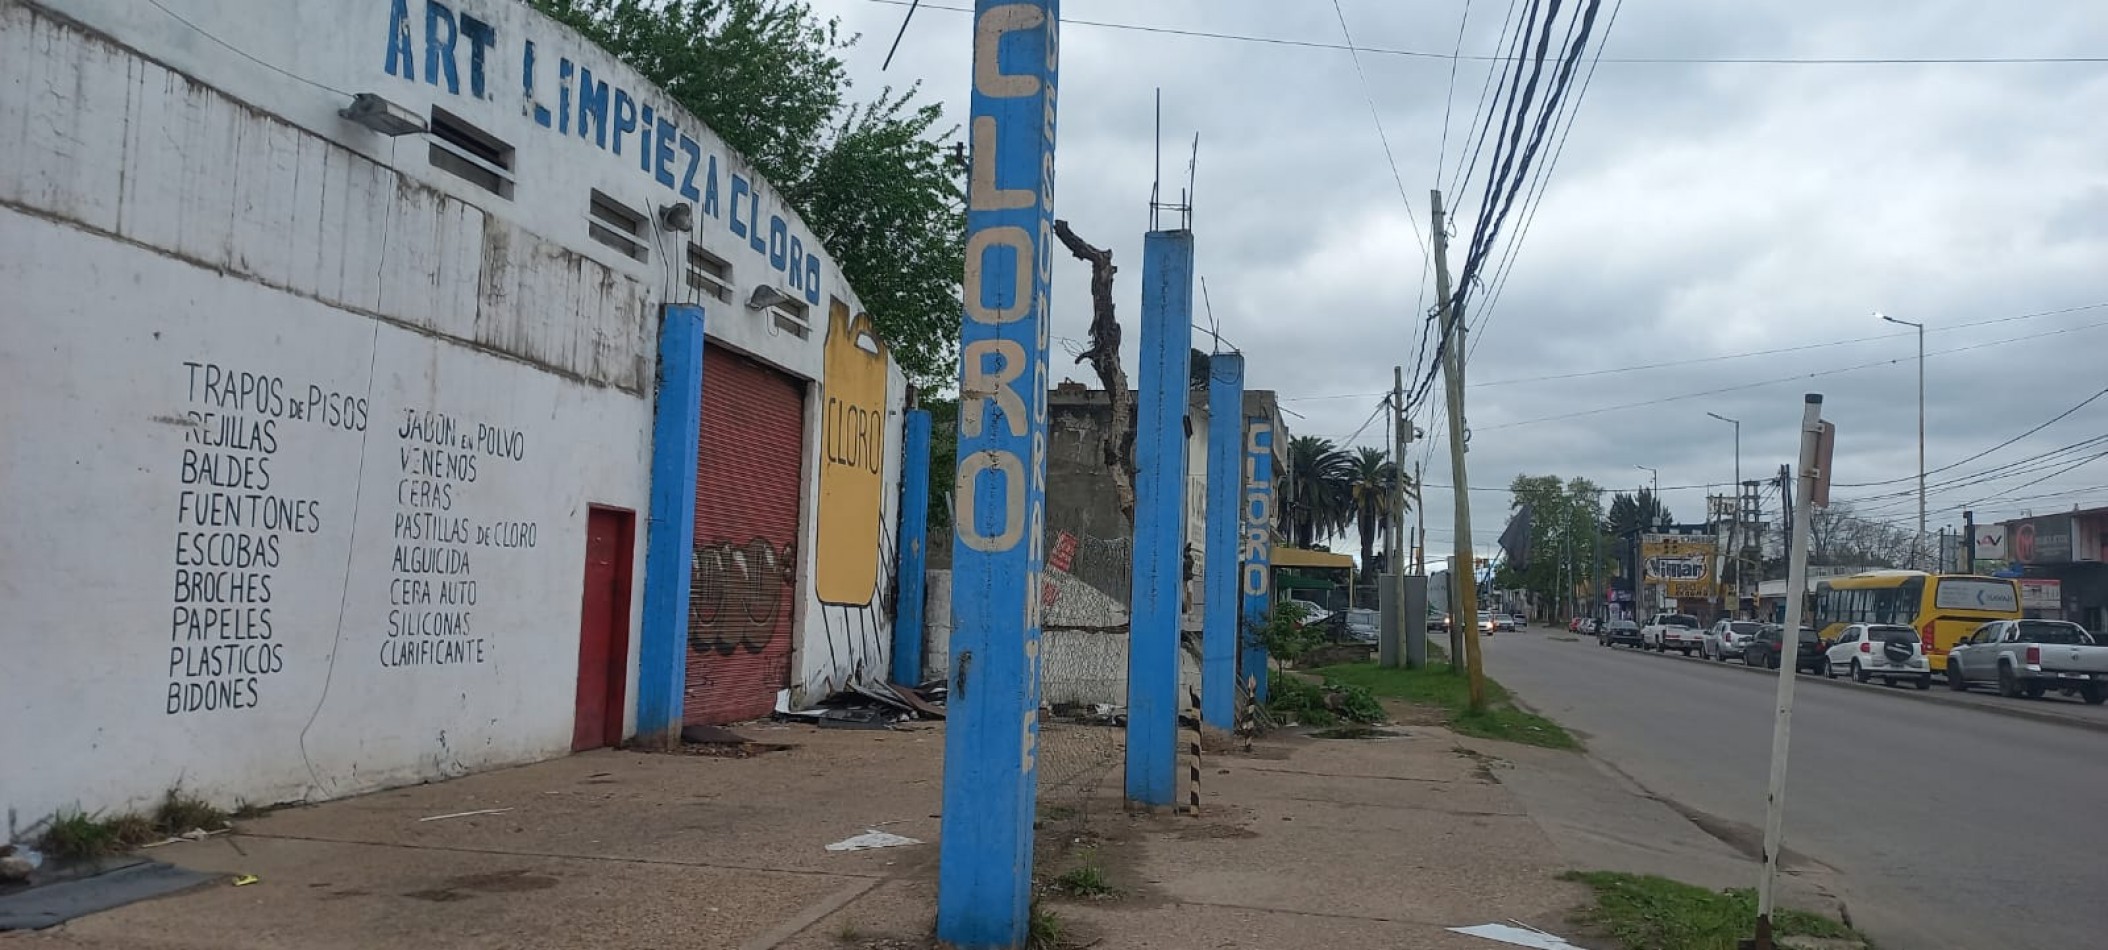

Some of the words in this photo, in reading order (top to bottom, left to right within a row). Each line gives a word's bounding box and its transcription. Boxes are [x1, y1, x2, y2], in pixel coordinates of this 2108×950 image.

[729, 173, 821, 306] CLORO
[956, 3, 1044, 552] CLORO
[183, 361, 283, 417] TRAPOS
[290, 398, 304, 420] DE
[307, 384, 367, 431] PISOS
[1022, 8, 1057, 773] DESODORANTE
[185, 410, 278, 454] REJILLAS
[461, 434, 474, 450] EN
[478, 423, 524, 461] POLVO
[827, 397, 881, 475] CLORO
[181, 449, 270, 491] BALDES
[178, 490, 320, 534] FUENTONES
[398, 478, 452, 511] CERAS
[1244, 422, 1271, 596] CLORO
[394, 512, 469, 544] PASTILLAS
[476, 526, 490, 547] DE
[494, 521, 537, 548] CLORO
[176, 532, 279, 568] ESCOBAS
[392, 544, 470, 575] ALGUICIDA
[174, 569, 271, 603] BROCHES
[390, 578, 431, 605] CERA
[439, 580, 477, 606] AUTO
[172, 606, 272, 642] PAPELES
[388, 609, 471, 638] SILICONAS
[169, 643, 283, 678] PLASTICOS
[380, 638, 484, 668] CLARIFICANTE
[166, 677, 258, 715] BIDONES
